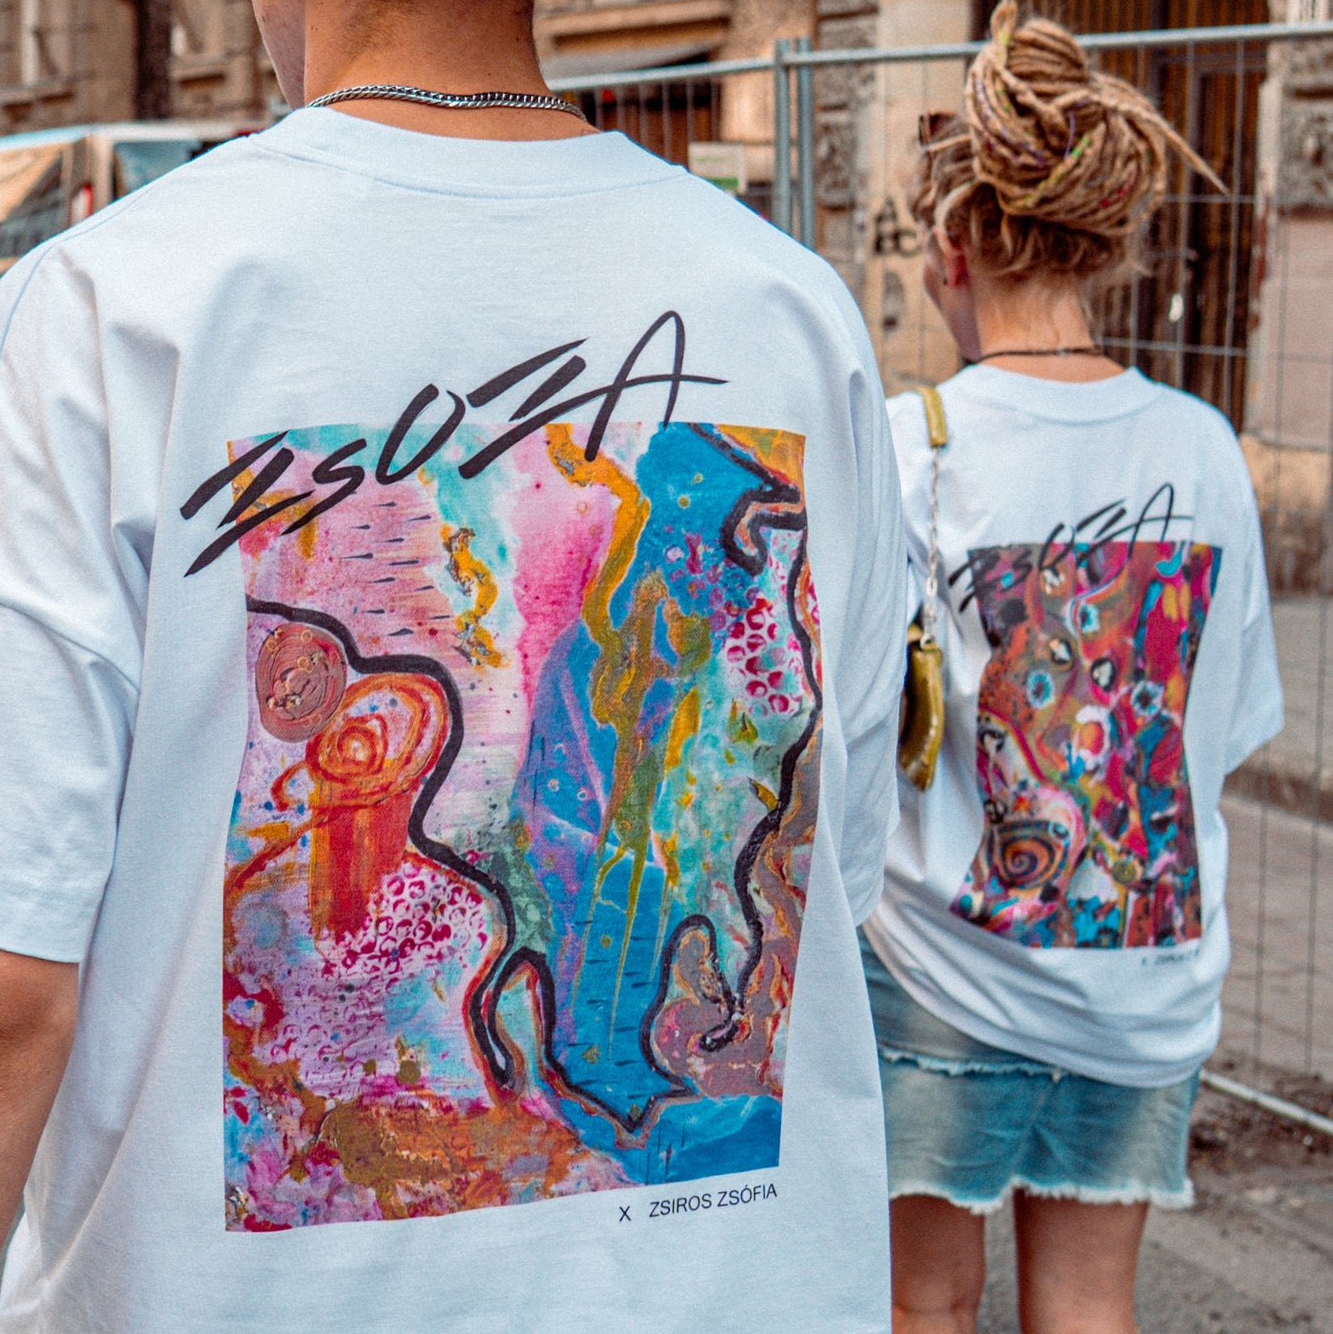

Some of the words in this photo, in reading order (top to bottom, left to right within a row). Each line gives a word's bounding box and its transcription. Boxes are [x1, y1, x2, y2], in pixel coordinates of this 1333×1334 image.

[177, 310, 728, 578] ZSOZA
[619, 1205, 632, 1222] X
[649, 1193, 713, 1218] ZSIROS
[717, 1182, 778, 1207] ZSÓFIA
